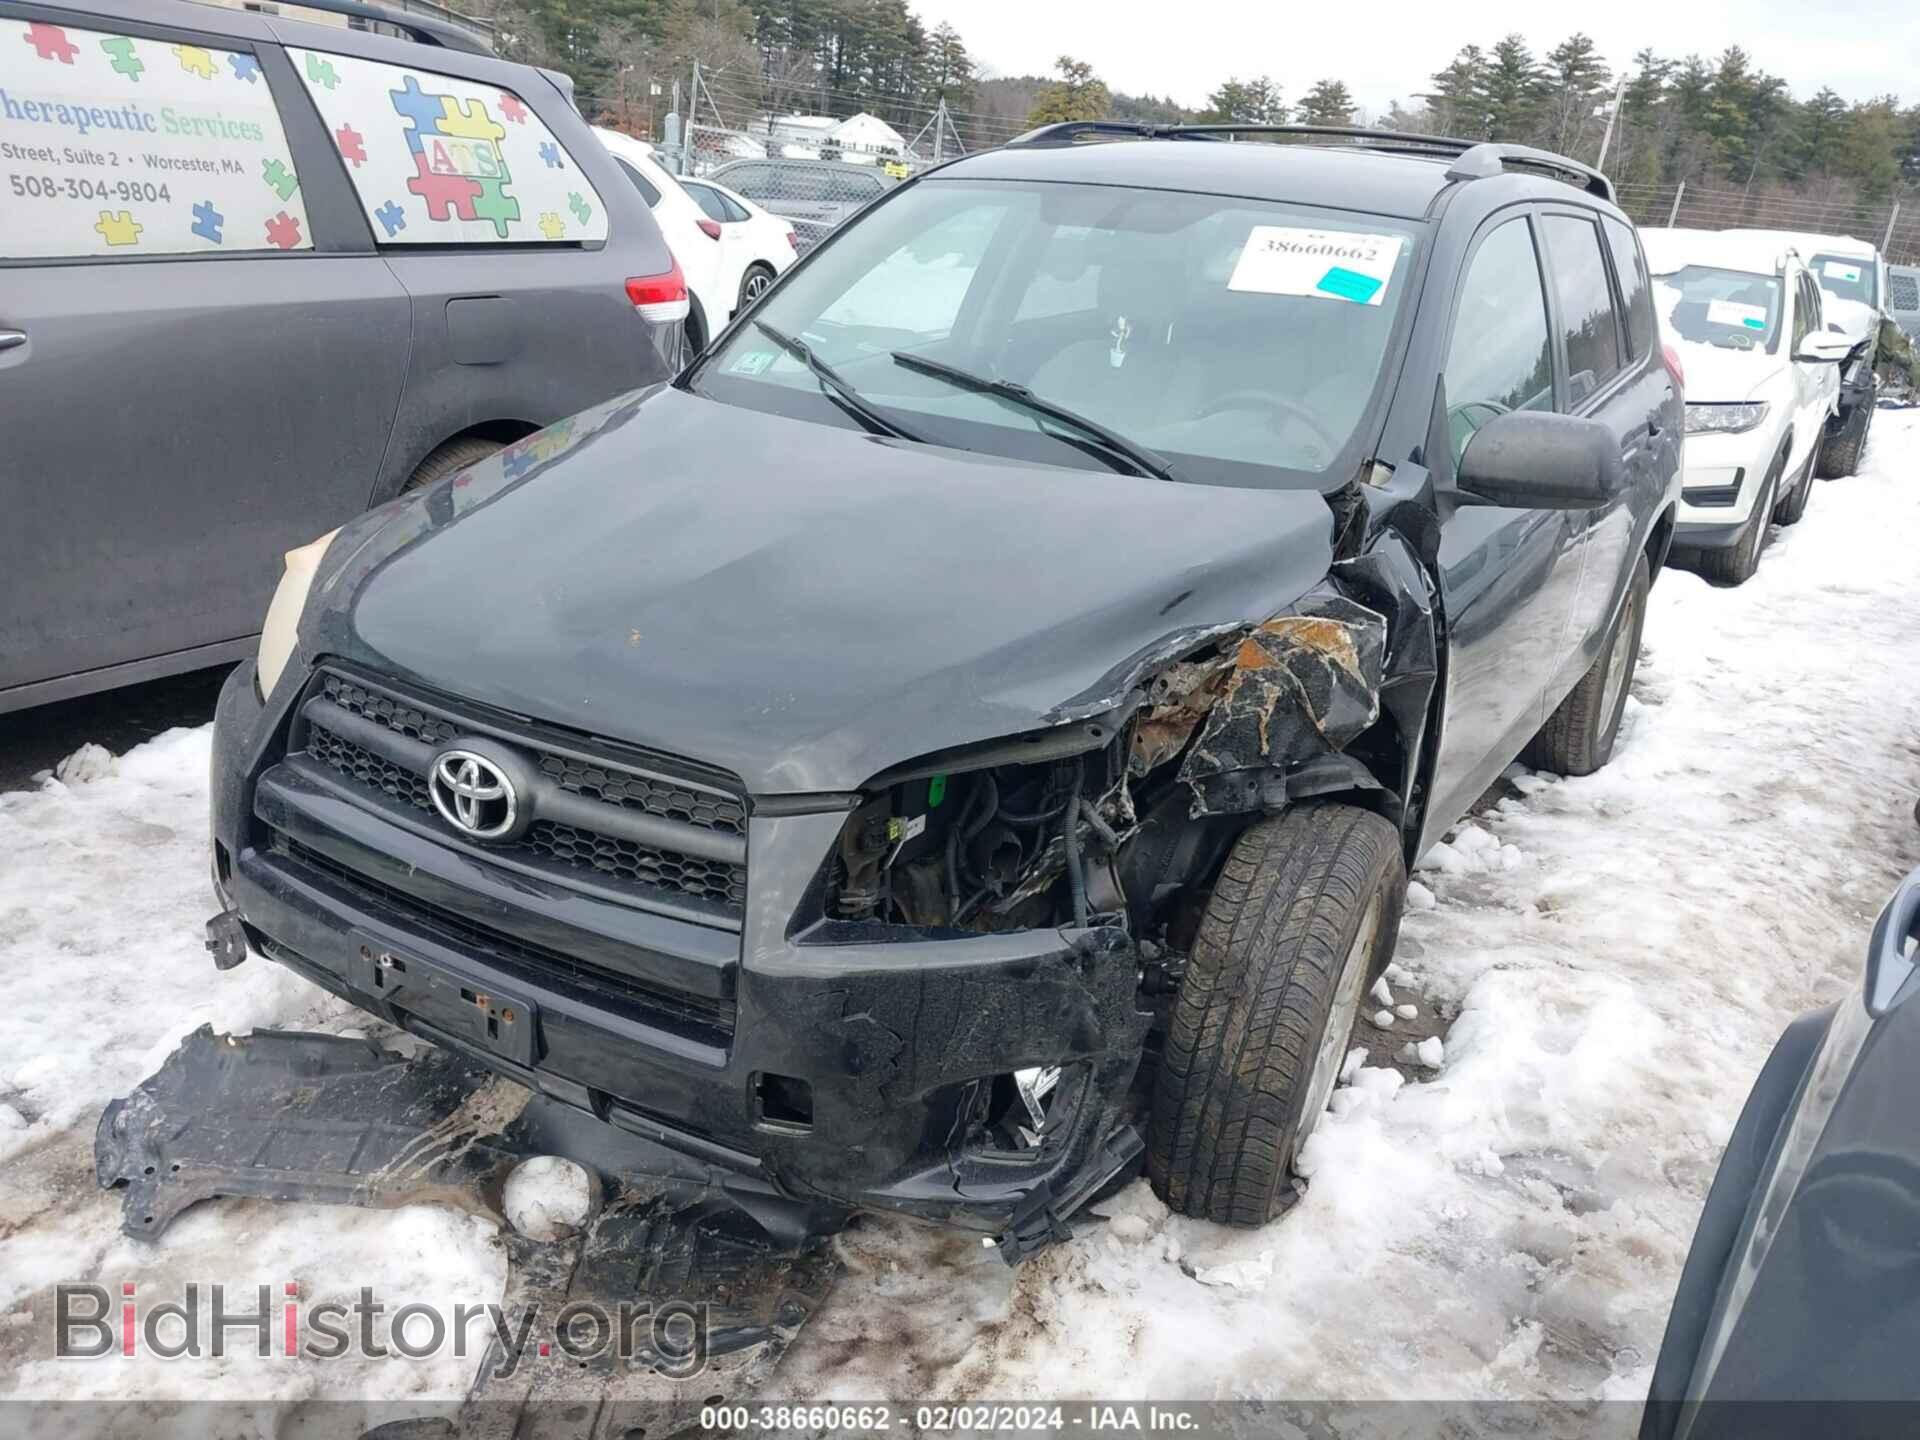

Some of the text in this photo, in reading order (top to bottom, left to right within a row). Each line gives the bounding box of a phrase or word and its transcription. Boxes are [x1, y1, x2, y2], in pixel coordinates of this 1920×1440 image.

[0, 88, 264, 142] herapeutic Services
[1, 142, 245, 175] Street, Suite 2 Worcester, MA
[431, 139, 498, 175] ATS
[10, 174, 171, 203] 508-304-9804
[1261, 239, 1378, 262] 38660662
